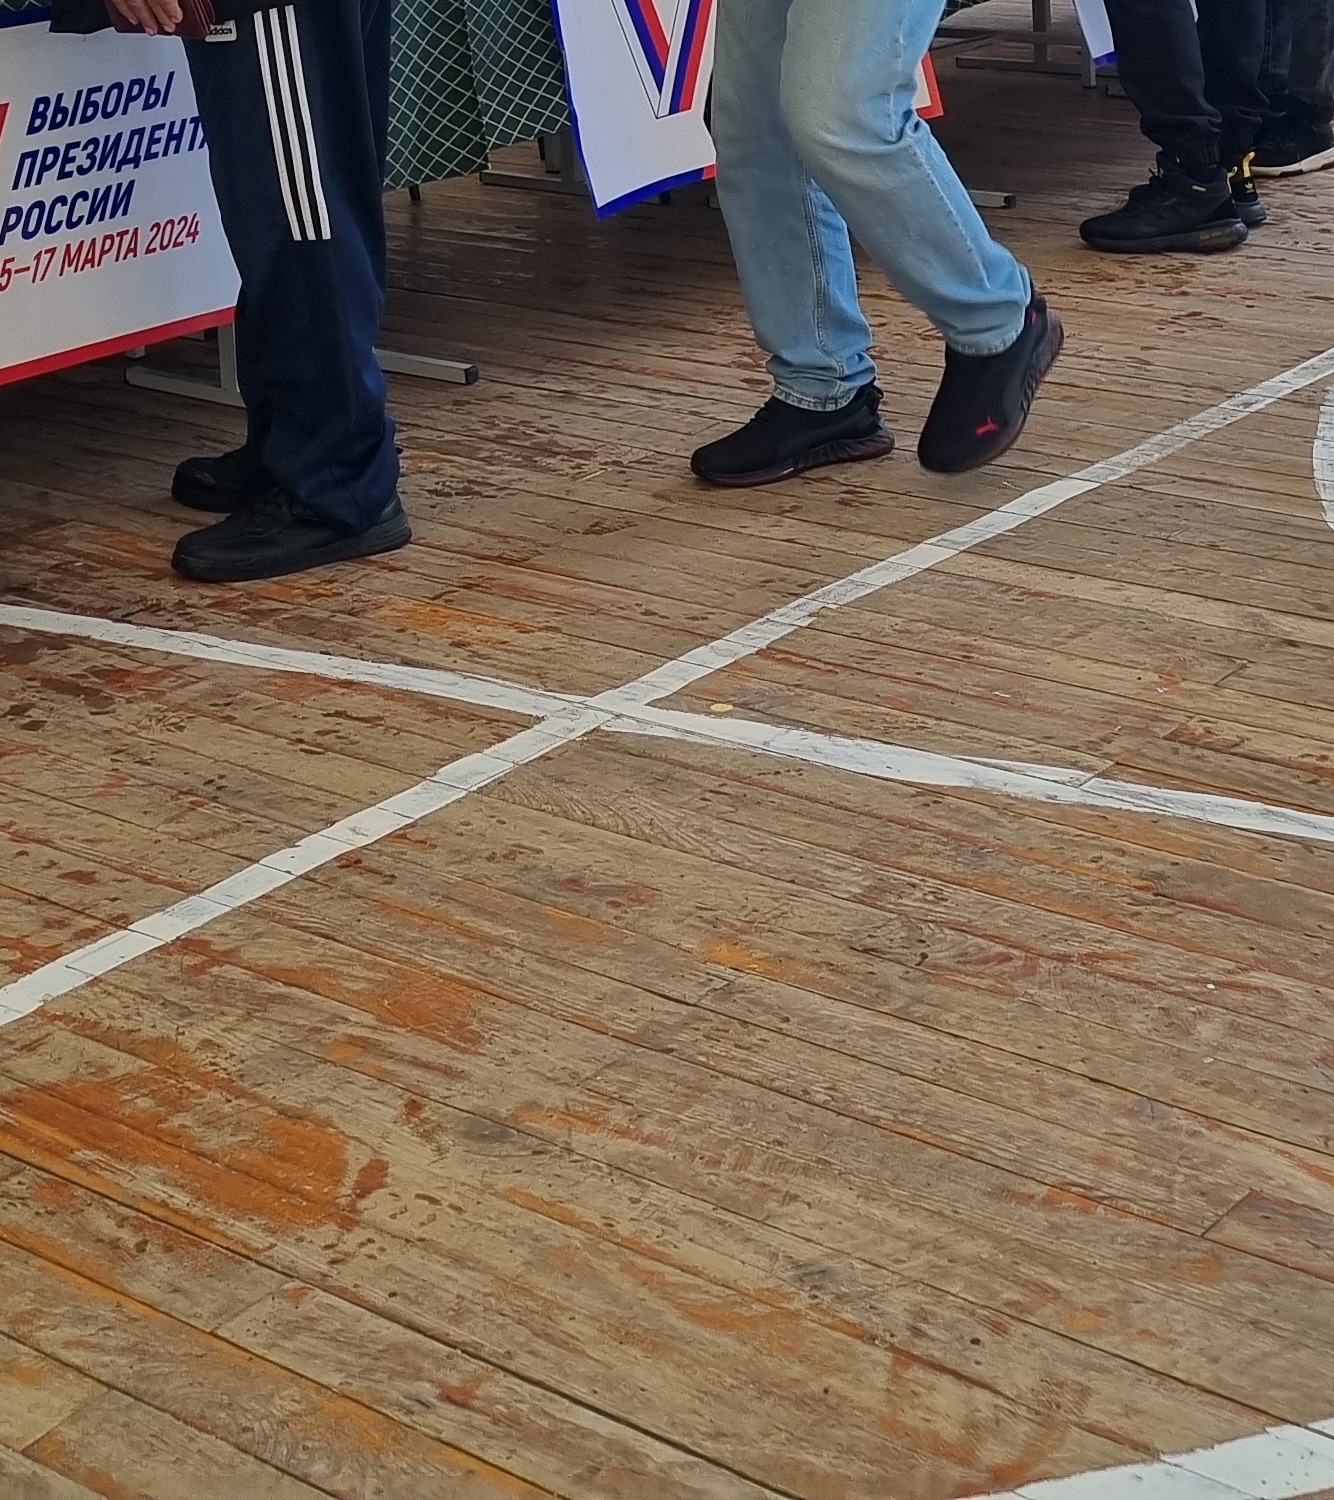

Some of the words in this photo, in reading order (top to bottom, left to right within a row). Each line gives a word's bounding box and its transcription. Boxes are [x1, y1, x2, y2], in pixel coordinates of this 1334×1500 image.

[26, 71, 175, 136] ВЫБОРЫ
[59, 226, 141, 278] МАРТА
[145, 212, 201, 256] 2024
